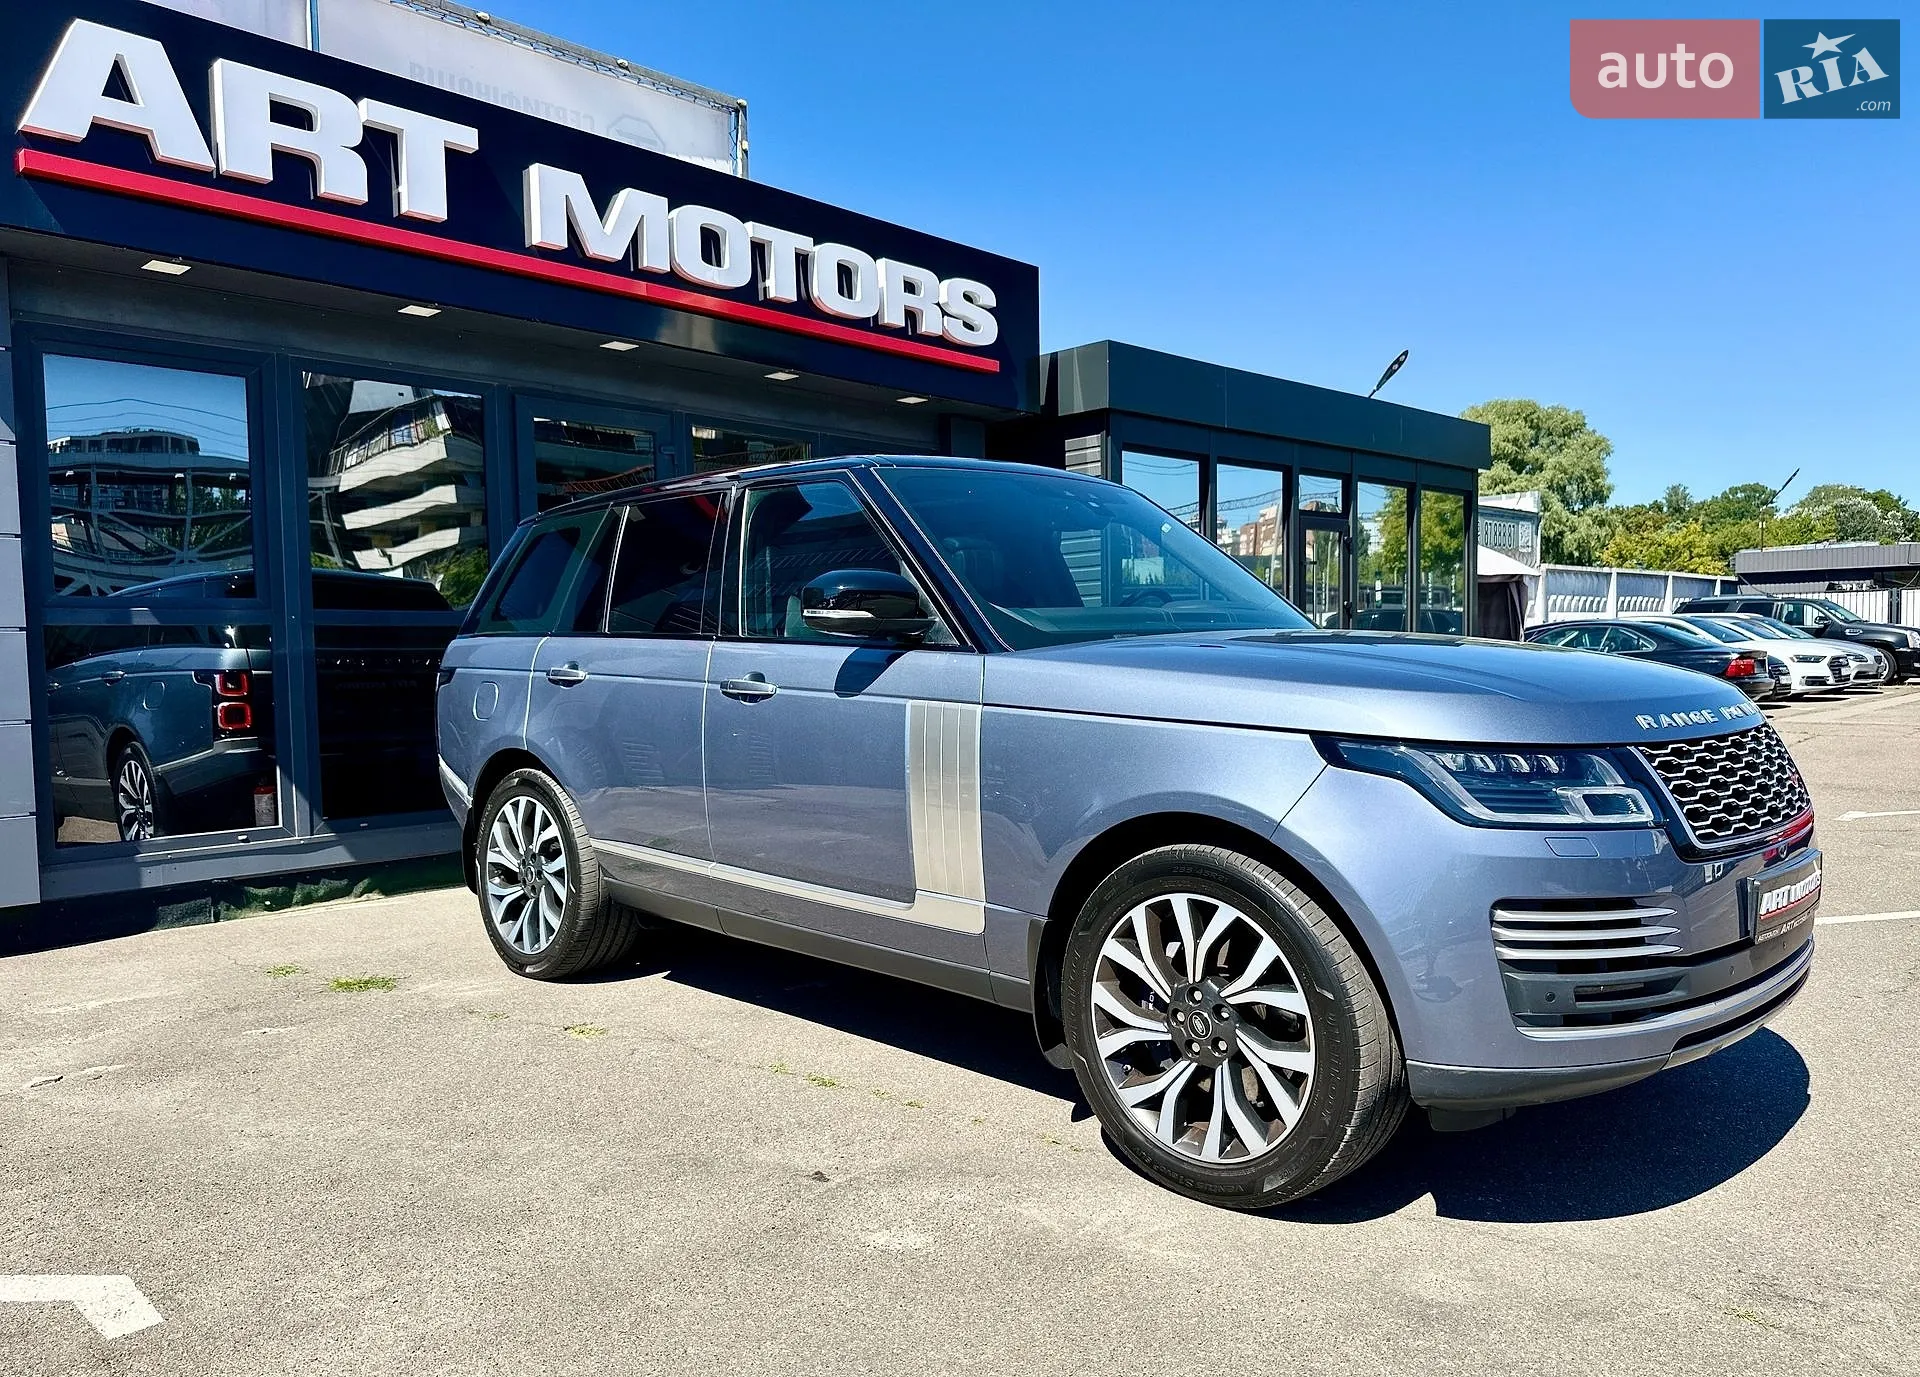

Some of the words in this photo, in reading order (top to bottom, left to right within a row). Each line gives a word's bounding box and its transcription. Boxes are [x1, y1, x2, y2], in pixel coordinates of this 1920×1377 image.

[18, 18, 477, 222] ART
[523, 162, 998, 347] MOTORS
[1635, 709, 1719, 730] RANGE
[1760, 885, 1791, 915] ART
